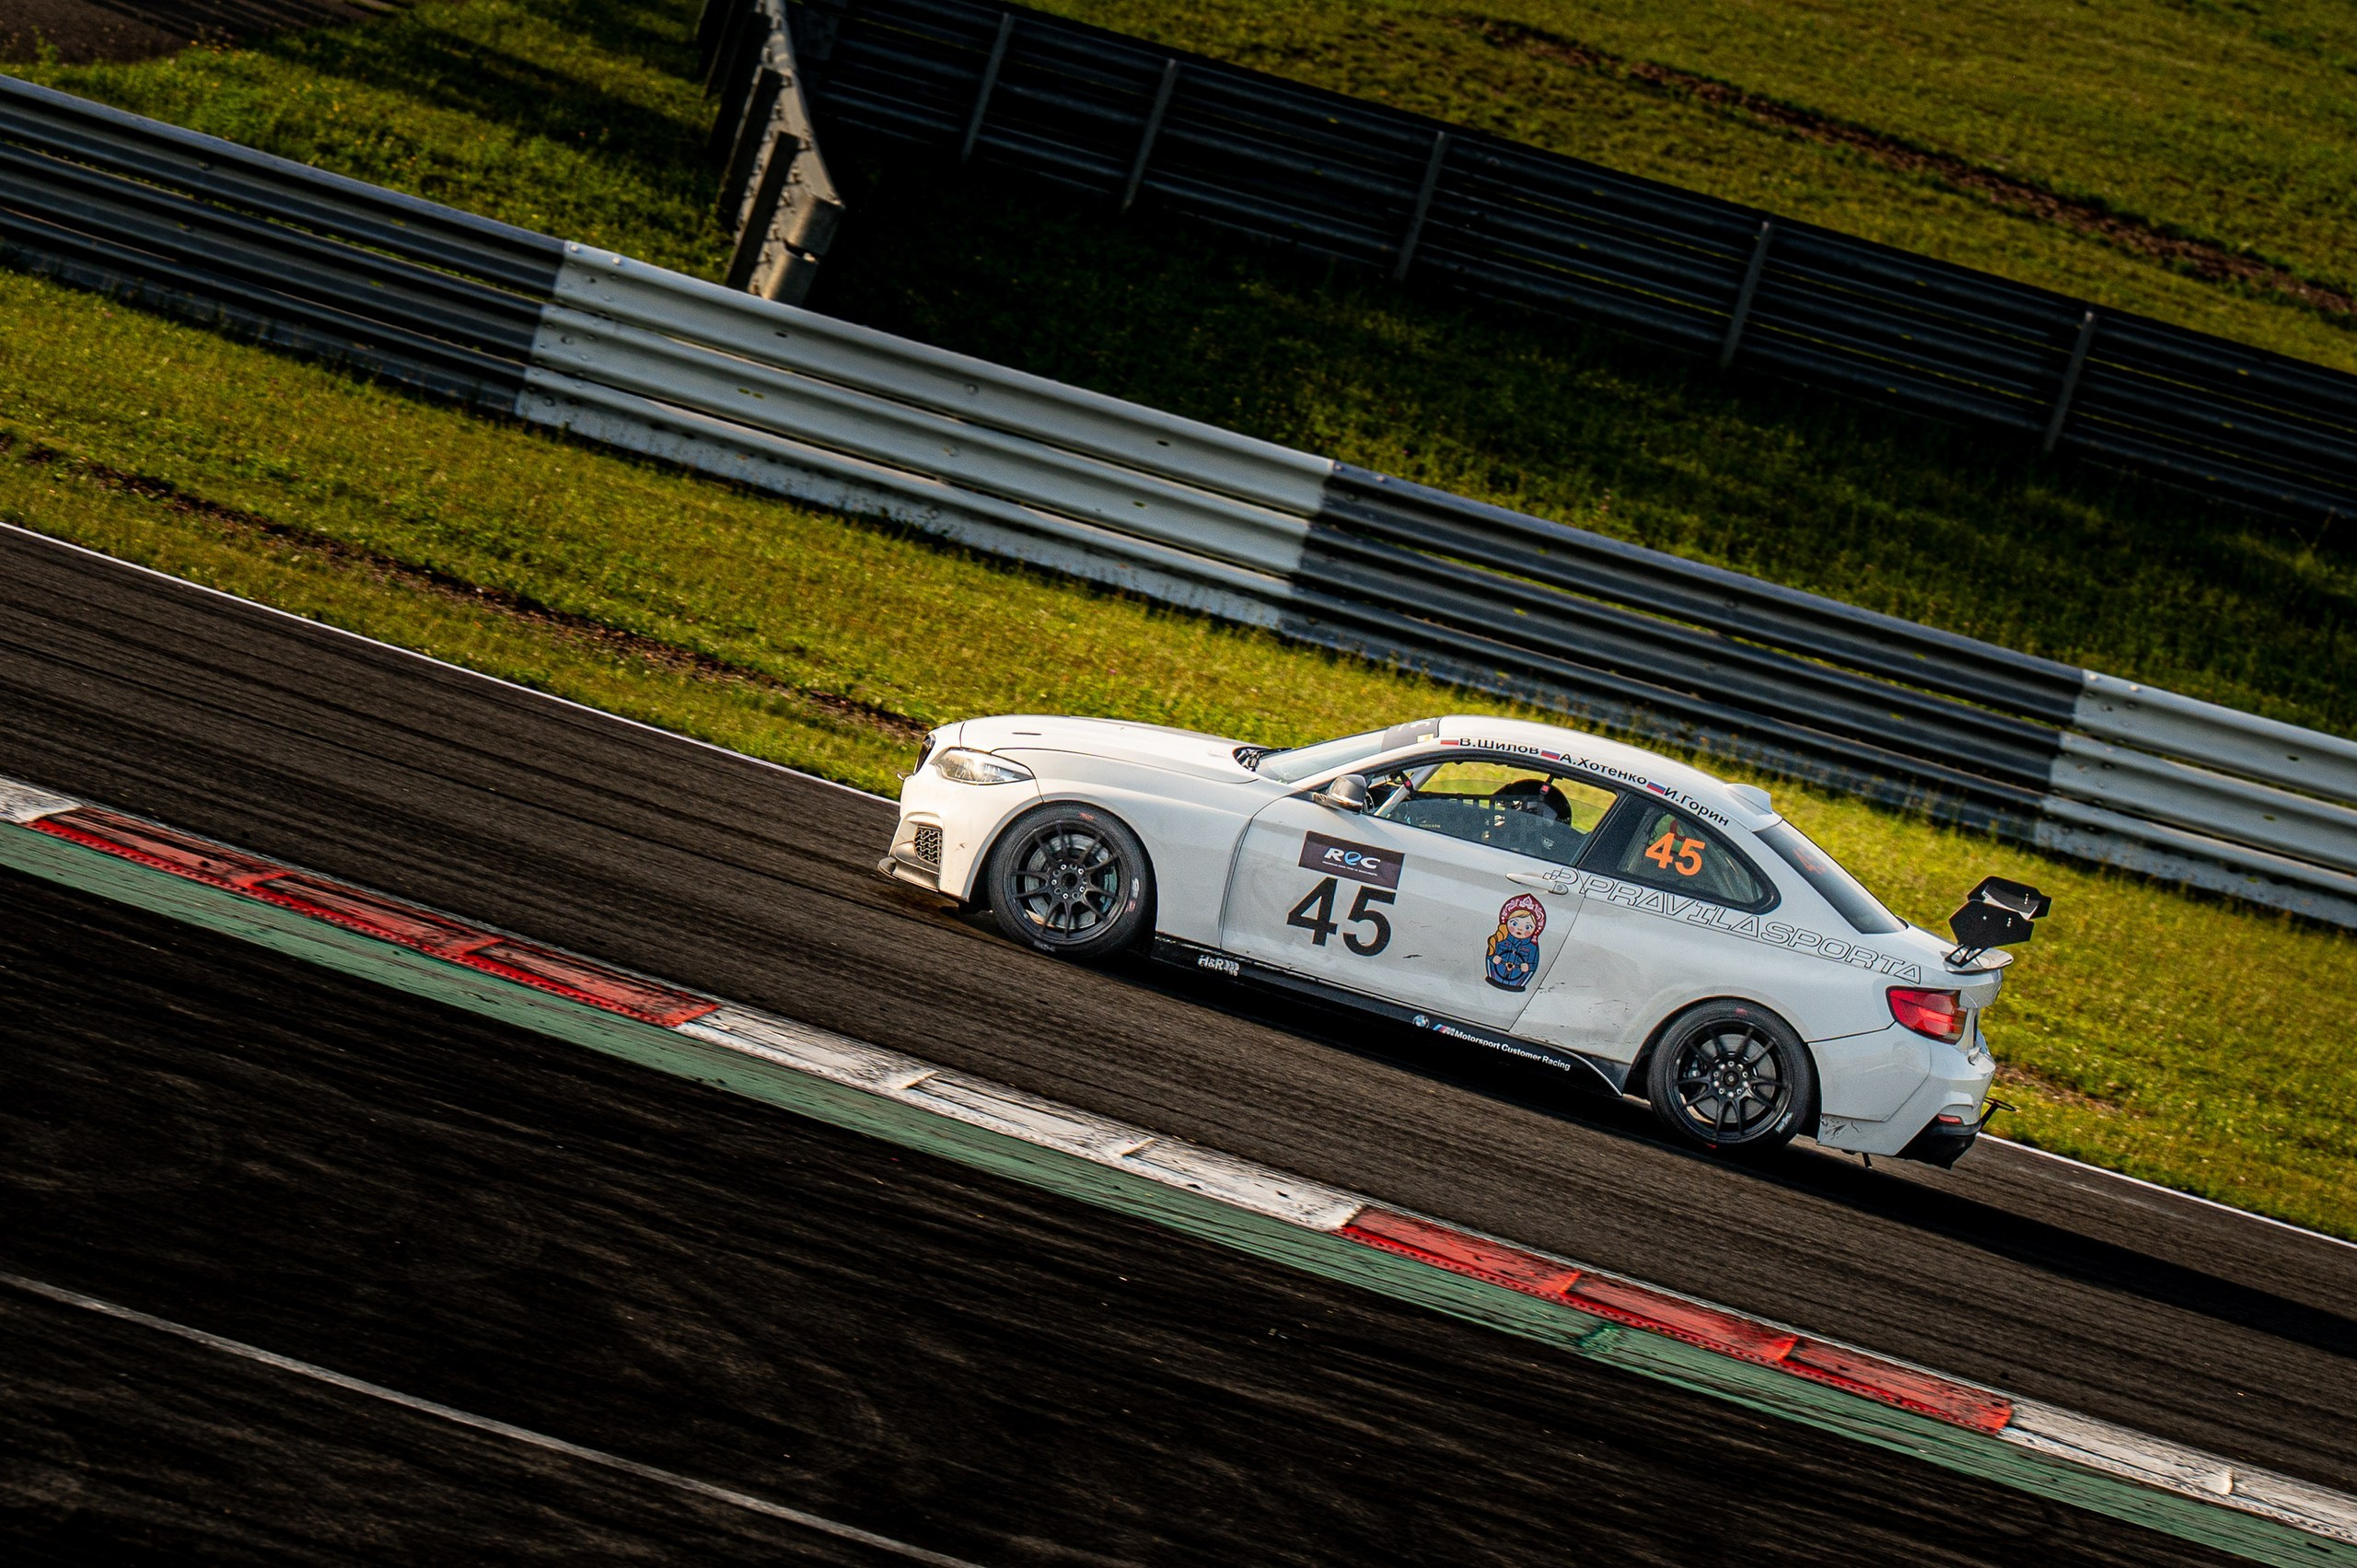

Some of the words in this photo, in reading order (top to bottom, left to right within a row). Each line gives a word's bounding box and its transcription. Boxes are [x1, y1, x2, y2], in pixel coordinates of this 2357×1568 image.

[1459, 738, 1539, 755] В.Шилов
[1559, 753, 1648, 785] А.Хотенко
[1664, 786, 1729, 827] И.Горин
[1644, 831, 1706, 877] 45
[1286, 876, 1397, 957] 45
[1455, 1030, 1501, 1050] Motorsport
[1501, 1043, 1541, 1061] Customer
[1541, 1055, 1571, 1071] Racing
